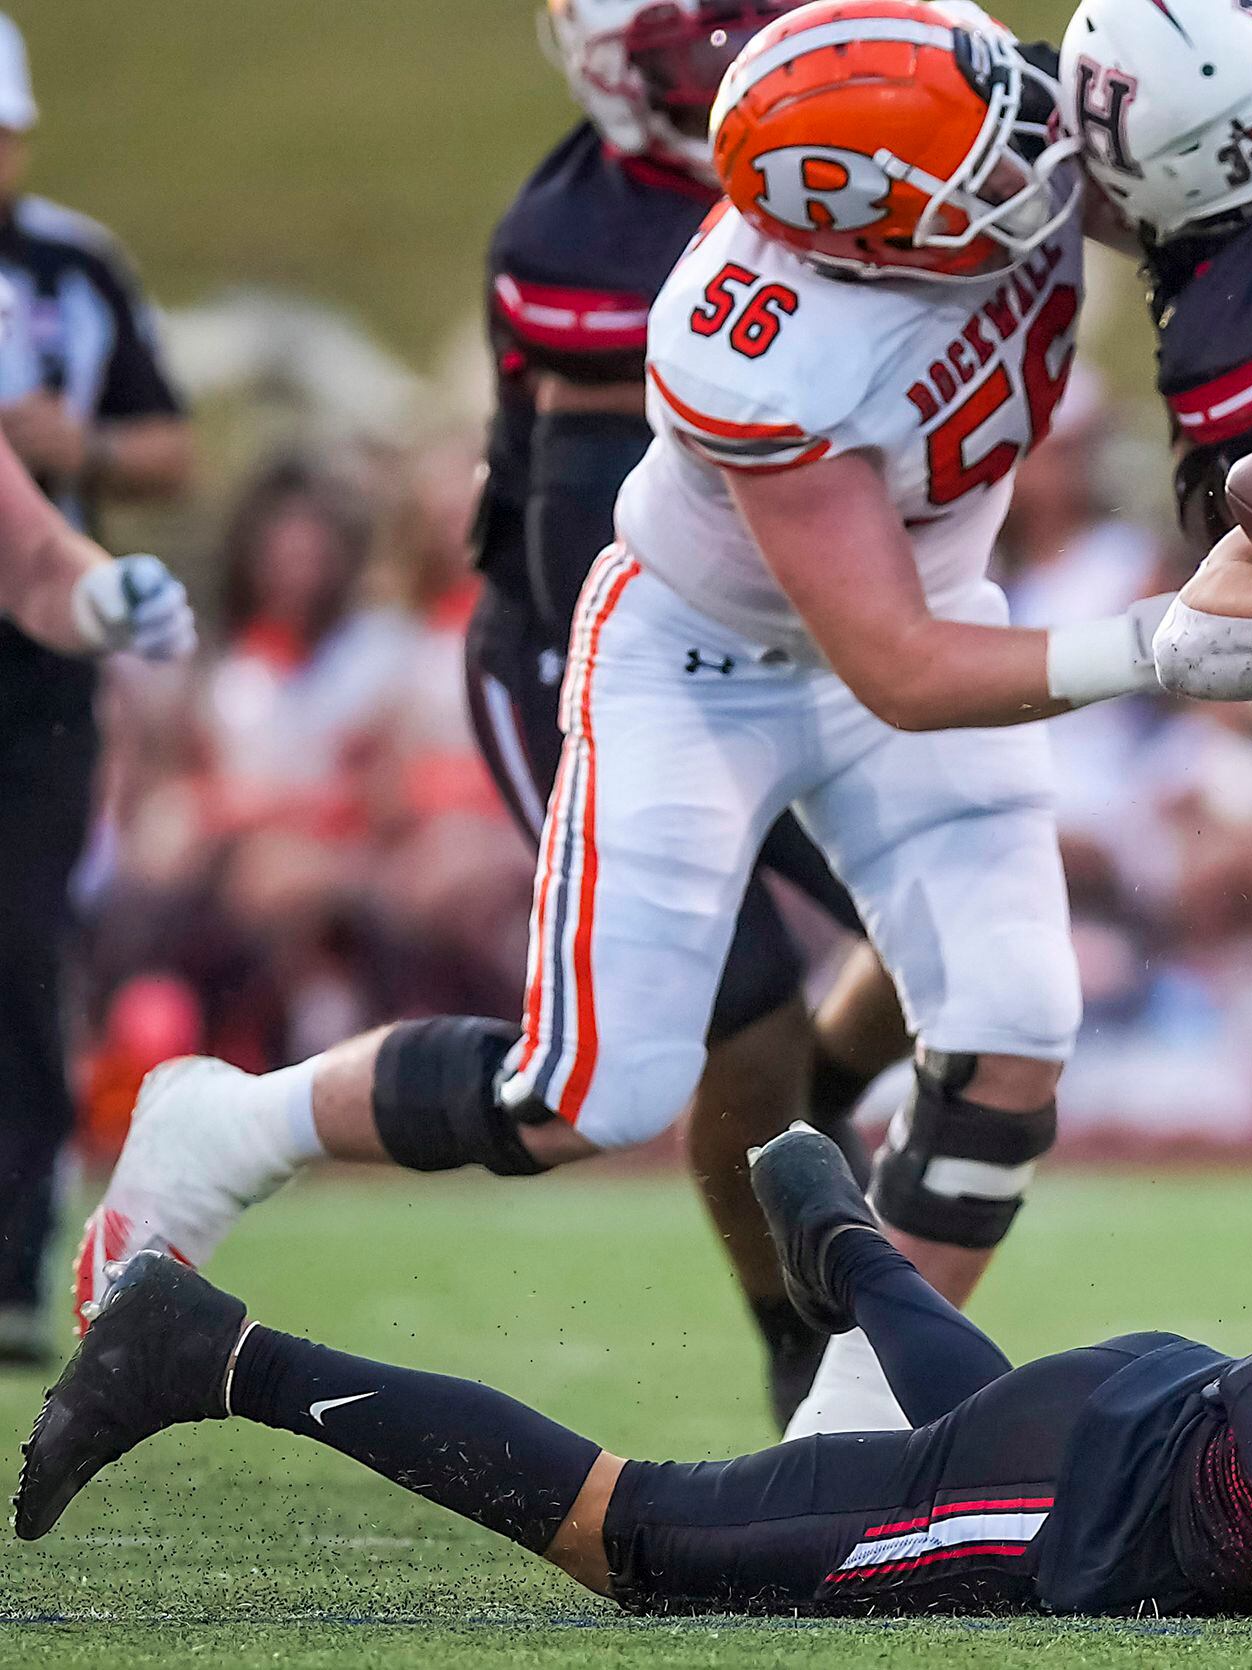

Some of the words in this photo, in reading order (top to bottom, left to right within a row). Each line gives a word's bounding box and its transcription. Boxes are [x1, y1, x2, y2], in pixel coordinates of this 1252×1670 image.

[1078, 55, 1145, 180] H
[752, 143, 891, 232] R
[690, 262, 799, 358] 56
